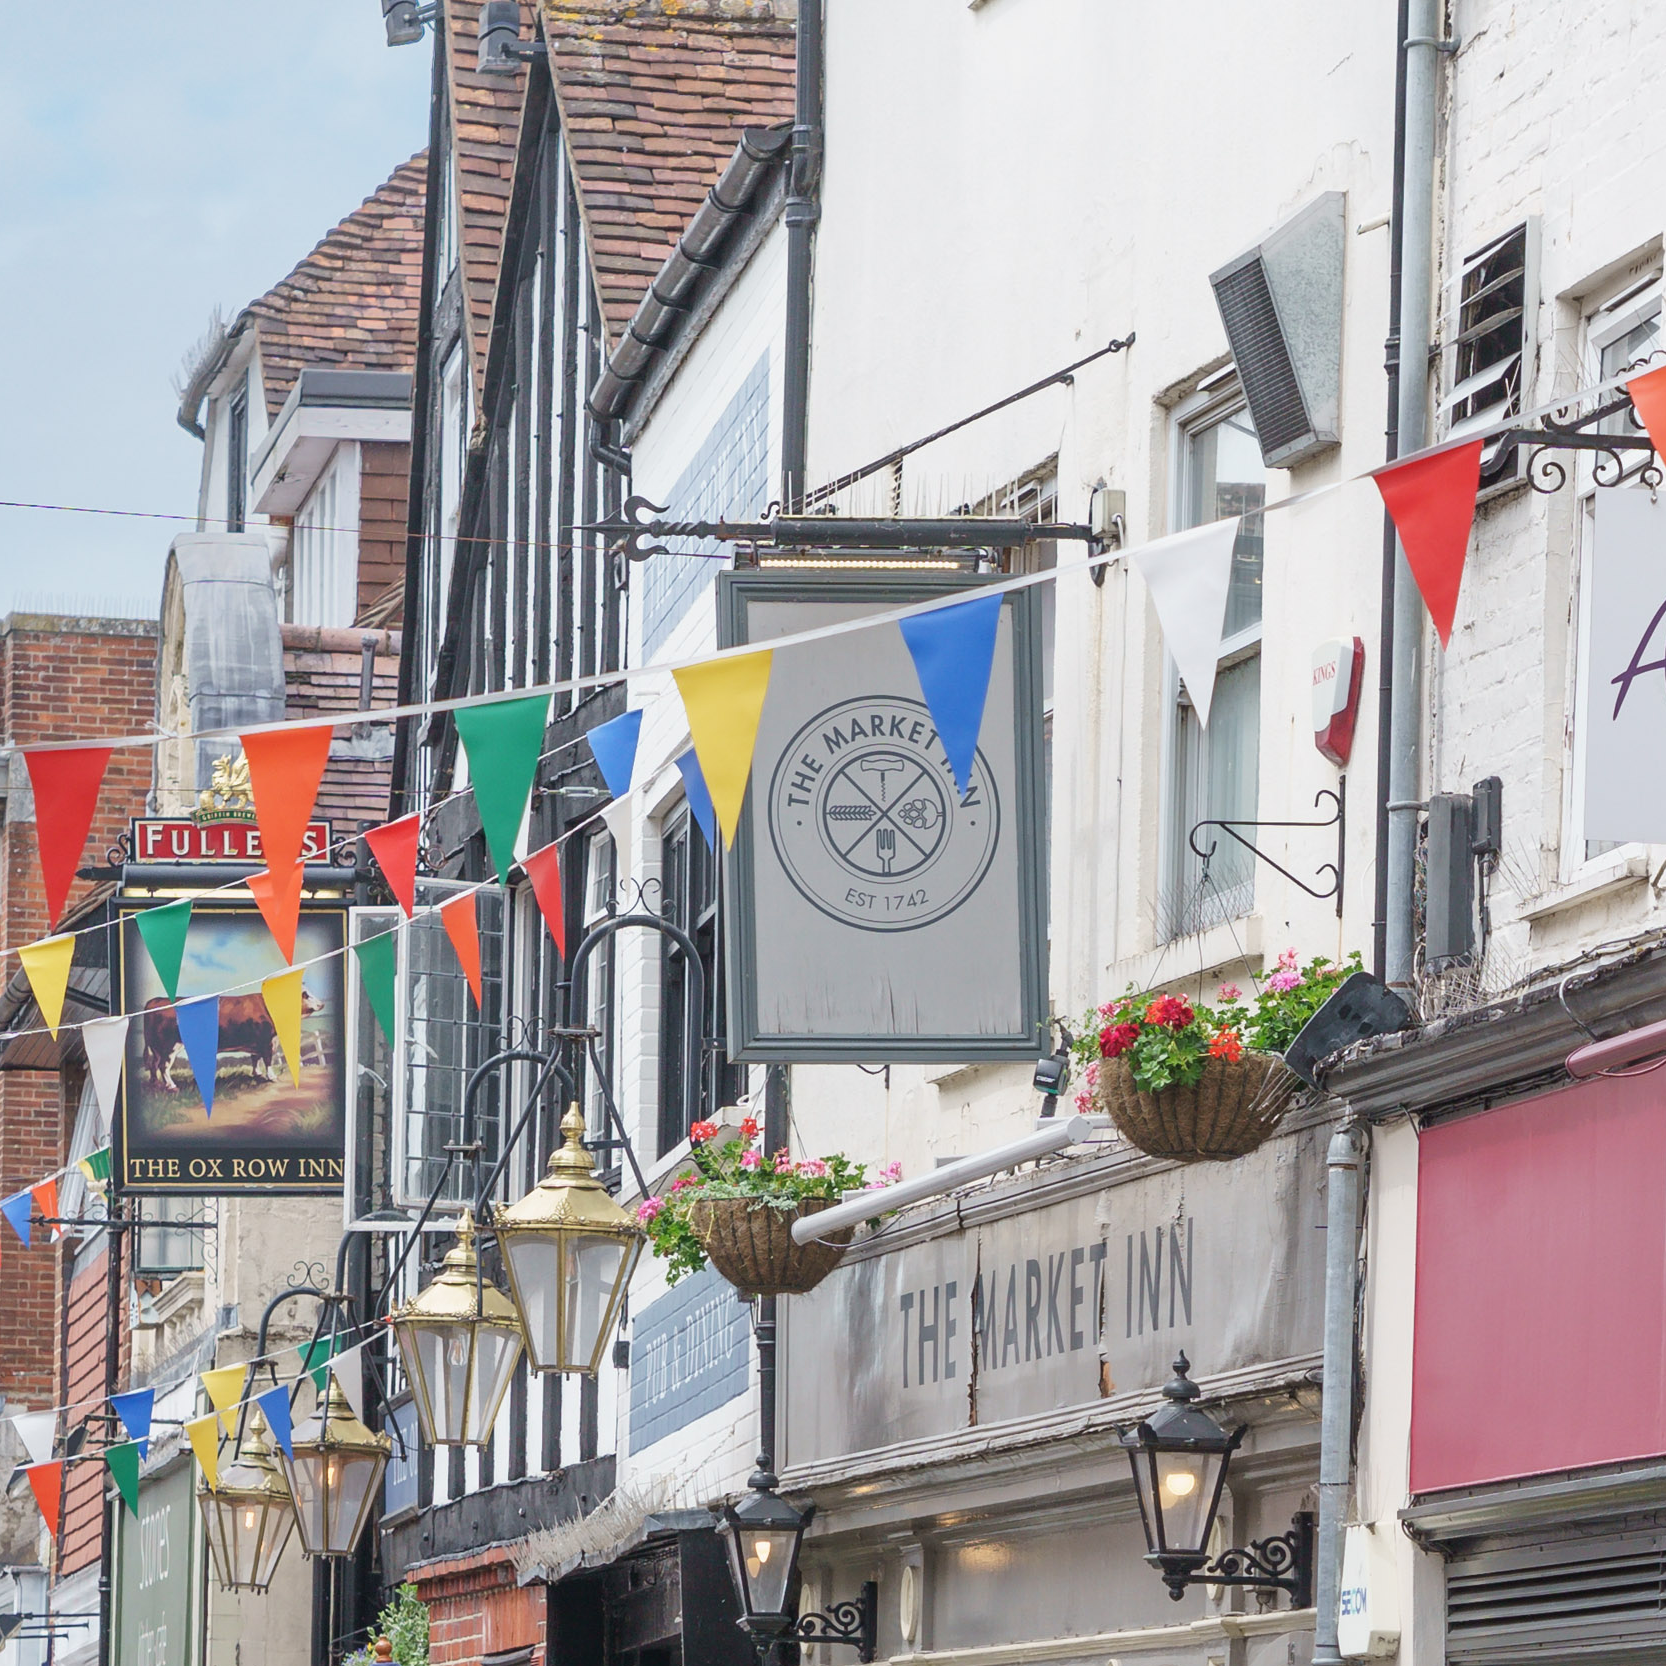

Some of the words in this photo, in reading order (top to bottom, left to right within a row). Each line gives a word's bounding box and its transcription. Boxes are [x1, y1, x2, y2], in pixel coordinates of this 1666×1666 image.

[1312, 660, 1337, 687] KINGS
[786, 753, 824, 809] THE
[822, 713, 941, 755] MARKET
[844, 886, 878, 910] EST
[883, 888, 930, 911] 1742
[130, 1158, 180, 1178] THE
[188, 1158, 225, 1178] OX
[232, 1158, 290, 1178] ROW
[298, 1157, 344, 1177] INN
[899, 1280, 958, 1389] THE
[974, 1242, 1108, 1372] MARKET
[1125, 1216, 1194, 1339] INN
[645, 1332, 668, 1409] PUB
[684, 1286, 734, 1384] DINING
[1341, 1587, 1367, 1616] SECOM
